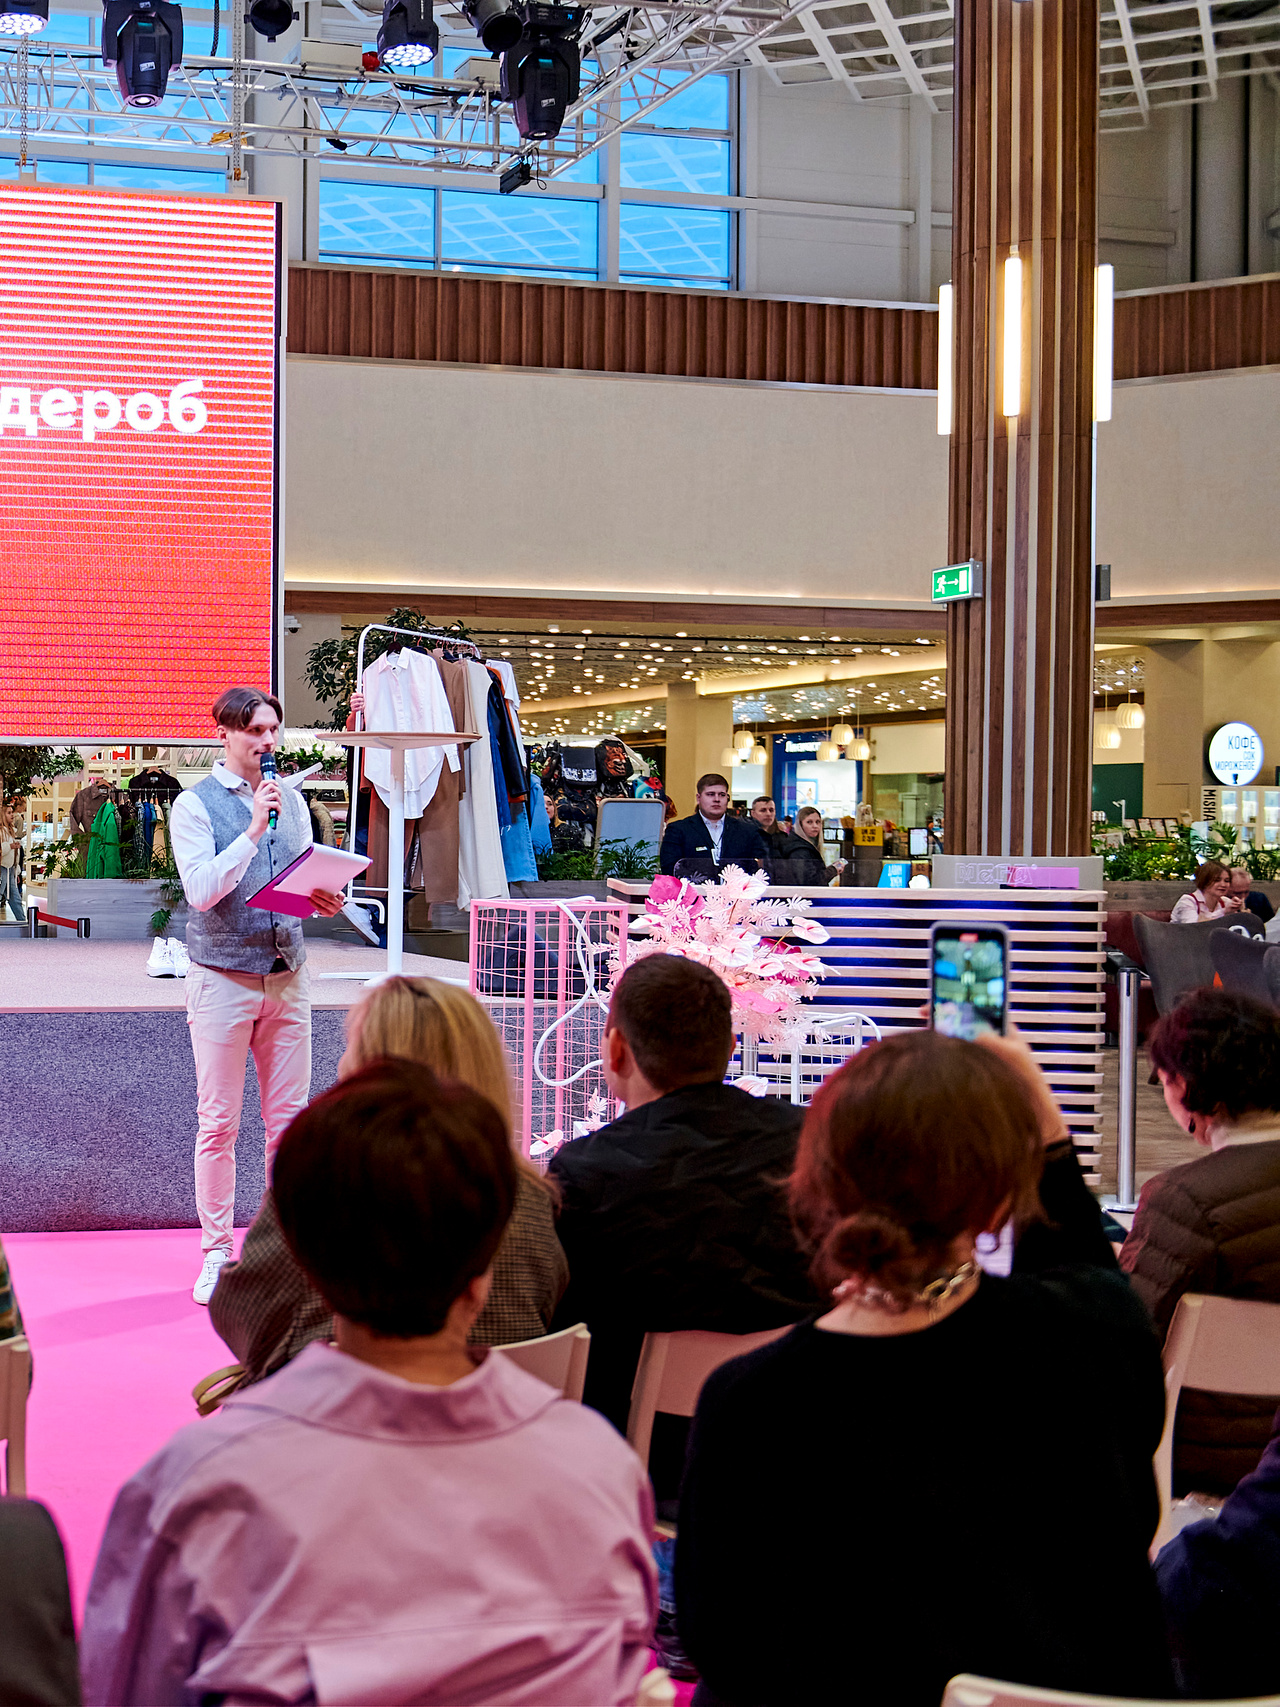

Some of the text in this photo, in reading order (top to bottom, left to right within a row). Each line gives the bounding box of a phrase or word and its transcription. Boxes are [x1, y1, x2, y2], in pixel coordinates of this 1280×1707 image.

[1228, 735, 1257, 749] КОФЕ
[1243, 751, 1256, 760] СОК
[1215, 761, 1256, 770] МОРОЖЕНОЕ
[1203, 789, 1217, 822] MISHA
